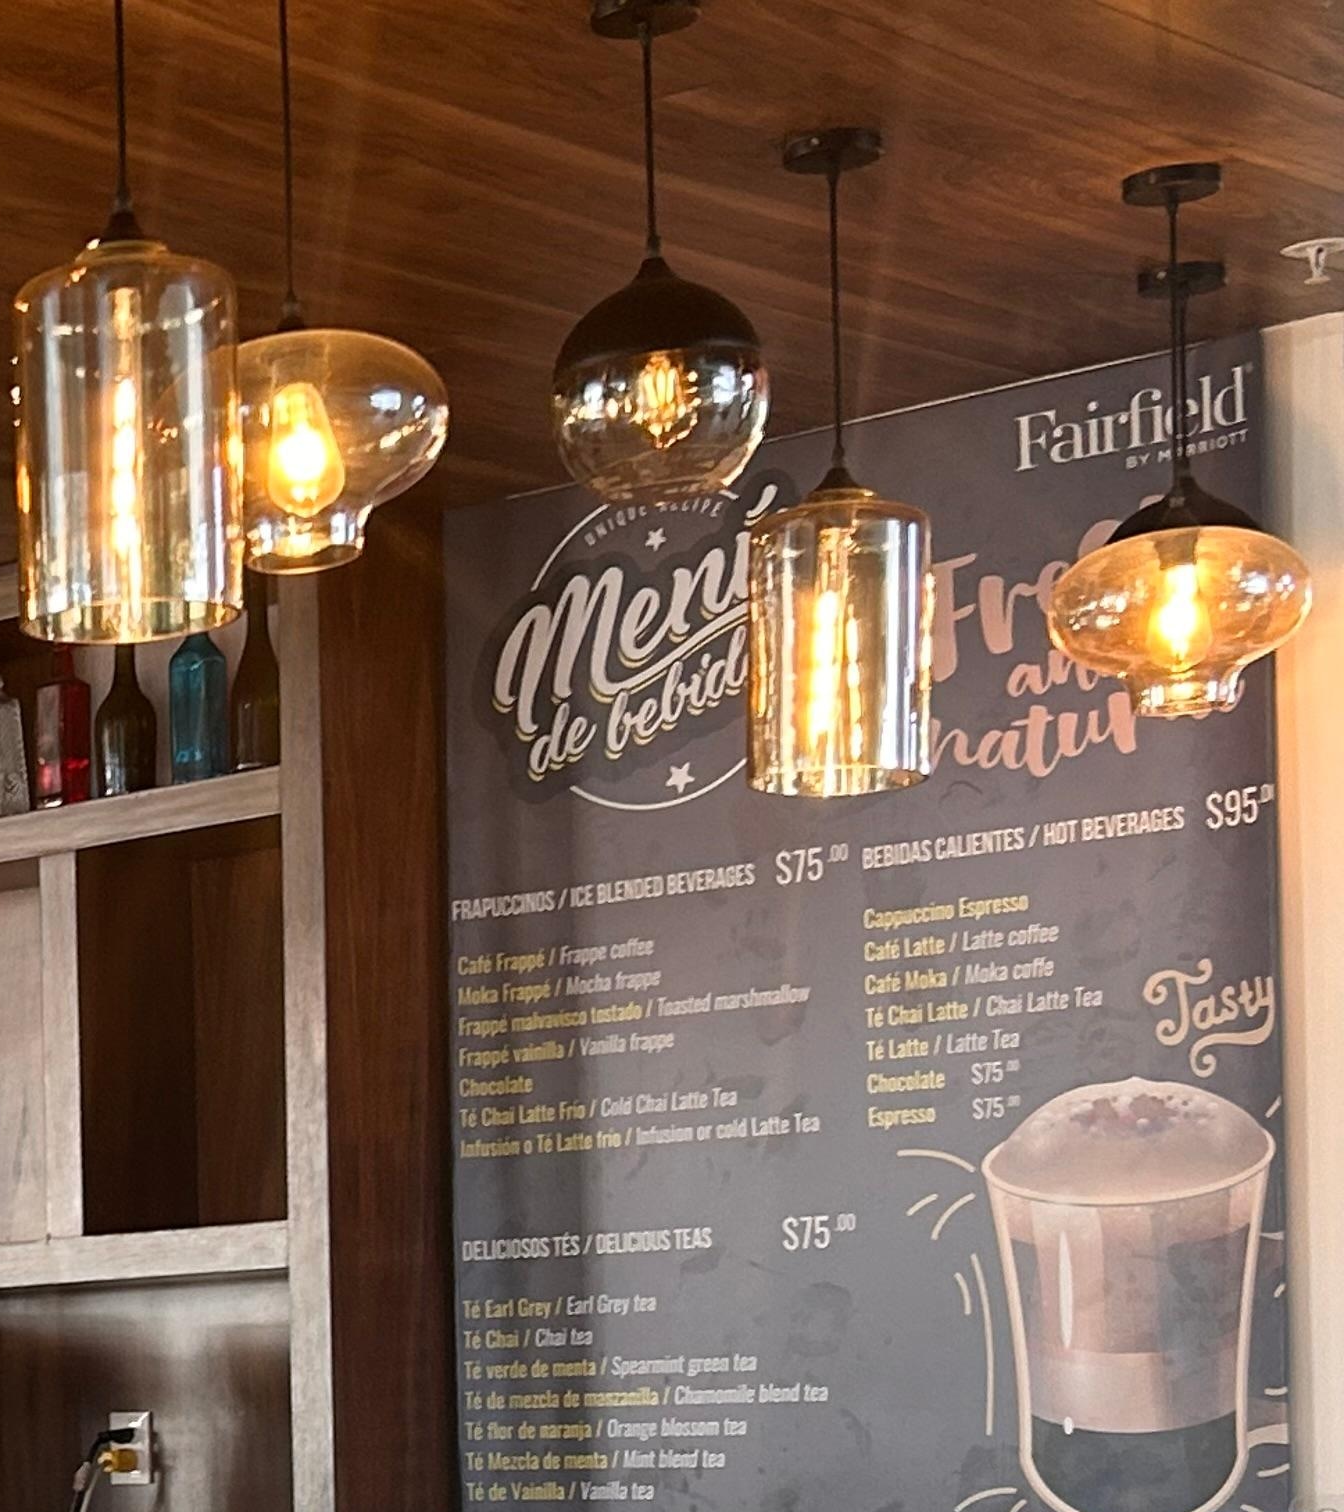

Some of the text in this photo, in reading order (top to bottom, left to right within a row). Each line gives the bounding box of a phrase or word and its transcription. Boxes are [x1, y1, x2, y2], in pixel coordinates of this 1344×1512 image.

[1014, 366, 1248, 472] Fairfield
[1125, 428, 1249, 470] BY MRRIOTT
[1006, 650, 1102, 698] an
[528, 624, 750, 782] de bebid
[862, 839, 933, 870] BEBIDAS
[934, 826, 1025, 860] CALIENTES
[1043, 819, 1078, 847] HOT
[1081, 806, 1185, 841] BEVERAGES
[451, 890, 555, 920] FRAPUCCINOS
[569, 884, 595, 907] ICE
[596, 875, 663, 904] BLENDED
[666, 863, 756, 895] BEVERAGES
[863, 895, 1029, 930] Cappuccino Espresso
[457, 954, 492, 975] Café
[496, 948, 545, 974] Frappé
[559, 945, 607, 967] Frappe
[610, 938, 655, 960] coffee
[863, 937, 900, 962] Café
[903, 935, 946, 958] Latte
[962, 930, 1005, 951] Latte
[1008, 923, 1060, 946] coffee
[458, 985, 498, 1005] Moka
[502, 979, 551, 1004] Frappé
[566, 974, 612, 995] Mocha
[615, 970, 662, 991] frappe
[864, 971, 901, 995] Café
[904, 968, 947, 991] Moka
[964, 961, 1008, 985] Moka
[458, 1014, 507, 1038] Frappé
[657, 992, 712, 1017] Toasted
[865, 1005, 884, 1028] Té
[887, 1002, 923, 1026] Chai
[927, 1000, 969, 1023] Latte
[985, 994, 1023, 1017] Chai
[1026, 991, 1069, 1013] Latte
[1074, 986, 1104, 1009] Tea
[1143, 958, 1276, 1078] Tasty
[459, 1046, 509, 1069] Frappé
[579, 1035, 627, 1056] Vanilla
[629, 1032, 675, 1053] frappe
[866, 1039, 885, 1061] Té
[888, 1038, 929, 1059] Latte
[946, 1033, 988, 1054] Latte
[991, 1028, 1020, 1050] Tea
[459, 1075, 534, 1097] Chocolate
[866, 1070, 946, 1094] Chocolate
[460, 1107, 477, 1128] Té
[481, 1106, 515, 1127] Chai
[519, 1103, 556, 1124] Latte
[601, 1096, 633, 1116] Cold
[635, 1092, 668, 1115] Chai
[671, 1091, 708, 1111] Latte
[711, 1087, 738, 1108] Tea
[868, 1106, 936, 1131] Espresso
[523, 1139, 532, 1154] o
[536, 1132, 553, 1153] Té
[556, 1132, 593, 1151] Latte
[636, 1125, 693, 1146] Infusion
[696, 1126, 712, 1141] or
[716, 1118, 747, 1139] cold
[751, 1116, 790, 1137] Latte
[793, 1112, 821, 1133] Tea
[462, 1236, 551, 1262] DELICIOSOS
[553, 1232, 580, 1257] TÉS
[595, 1229, 671, 1254] DELICIOUS
[672, 1226, 712, 1250] TEAS
[462, 1299, 481, 1319] Té
[484, 1299, 514, 1319] Earl
[518, 1297, 552, 1320] Grey
[567, 1295, 594, 1316] Earl
[596, 1294, 630, 1316] Grey
[633, 1294, 657, 1312] tea
[463, 1330, 481, 1350] Té
[485, 1329, 519, 1349] Chai
[535, 1328, 567, 1347] Chai
[570, 1328, 593, 1346] tea
[464, 1360, 482, 1380] Té
[485, 1359, 528, 1379] verde
[531, 1359, 550, 1378] de
[552, 1359, 596, 1377] menta
[611, 1354, 685, 1379] Spearmint
[687, 1356, 729, 1377] green
[733, 1353, 758, 1372] tea
[464, 1390, 482, 1410] Té
[486, 1390, 505, 1409] de
[509, 1389, 560, 1409] mezcla
[563, 1388, 580, 1408] de
[758, 1381, 800, 1403] blend
[803, 1384, 829, 1402] tea
[465, 1421, 483, 1440] Té
[487, 1421, 513, 1440] flor
[518, 1421, 536, 1440] de
[607, 1418, 658, 1441] Orange
[660, 1417, 720, 1437] blossom
[723, 1417, 747, 1436] tea
[465, 1452, 484, 1471] Té
[488, 1451, 539, 1470] Mezcla
[542, 1451, 561, 1470] de
[563, 1451, 608, 1469] menta
[623, 1449, 656, 1469] Mint
[658, 1449, 699, 1469] blend
[702, 1450, 726, 1469] tea
[466, 1481, 485, 1501] Té
[488, 1481, 507, 1500] de
[580, 1481, 628, 1500] Vanilla
[631, 1483, 654, 1500] tea
